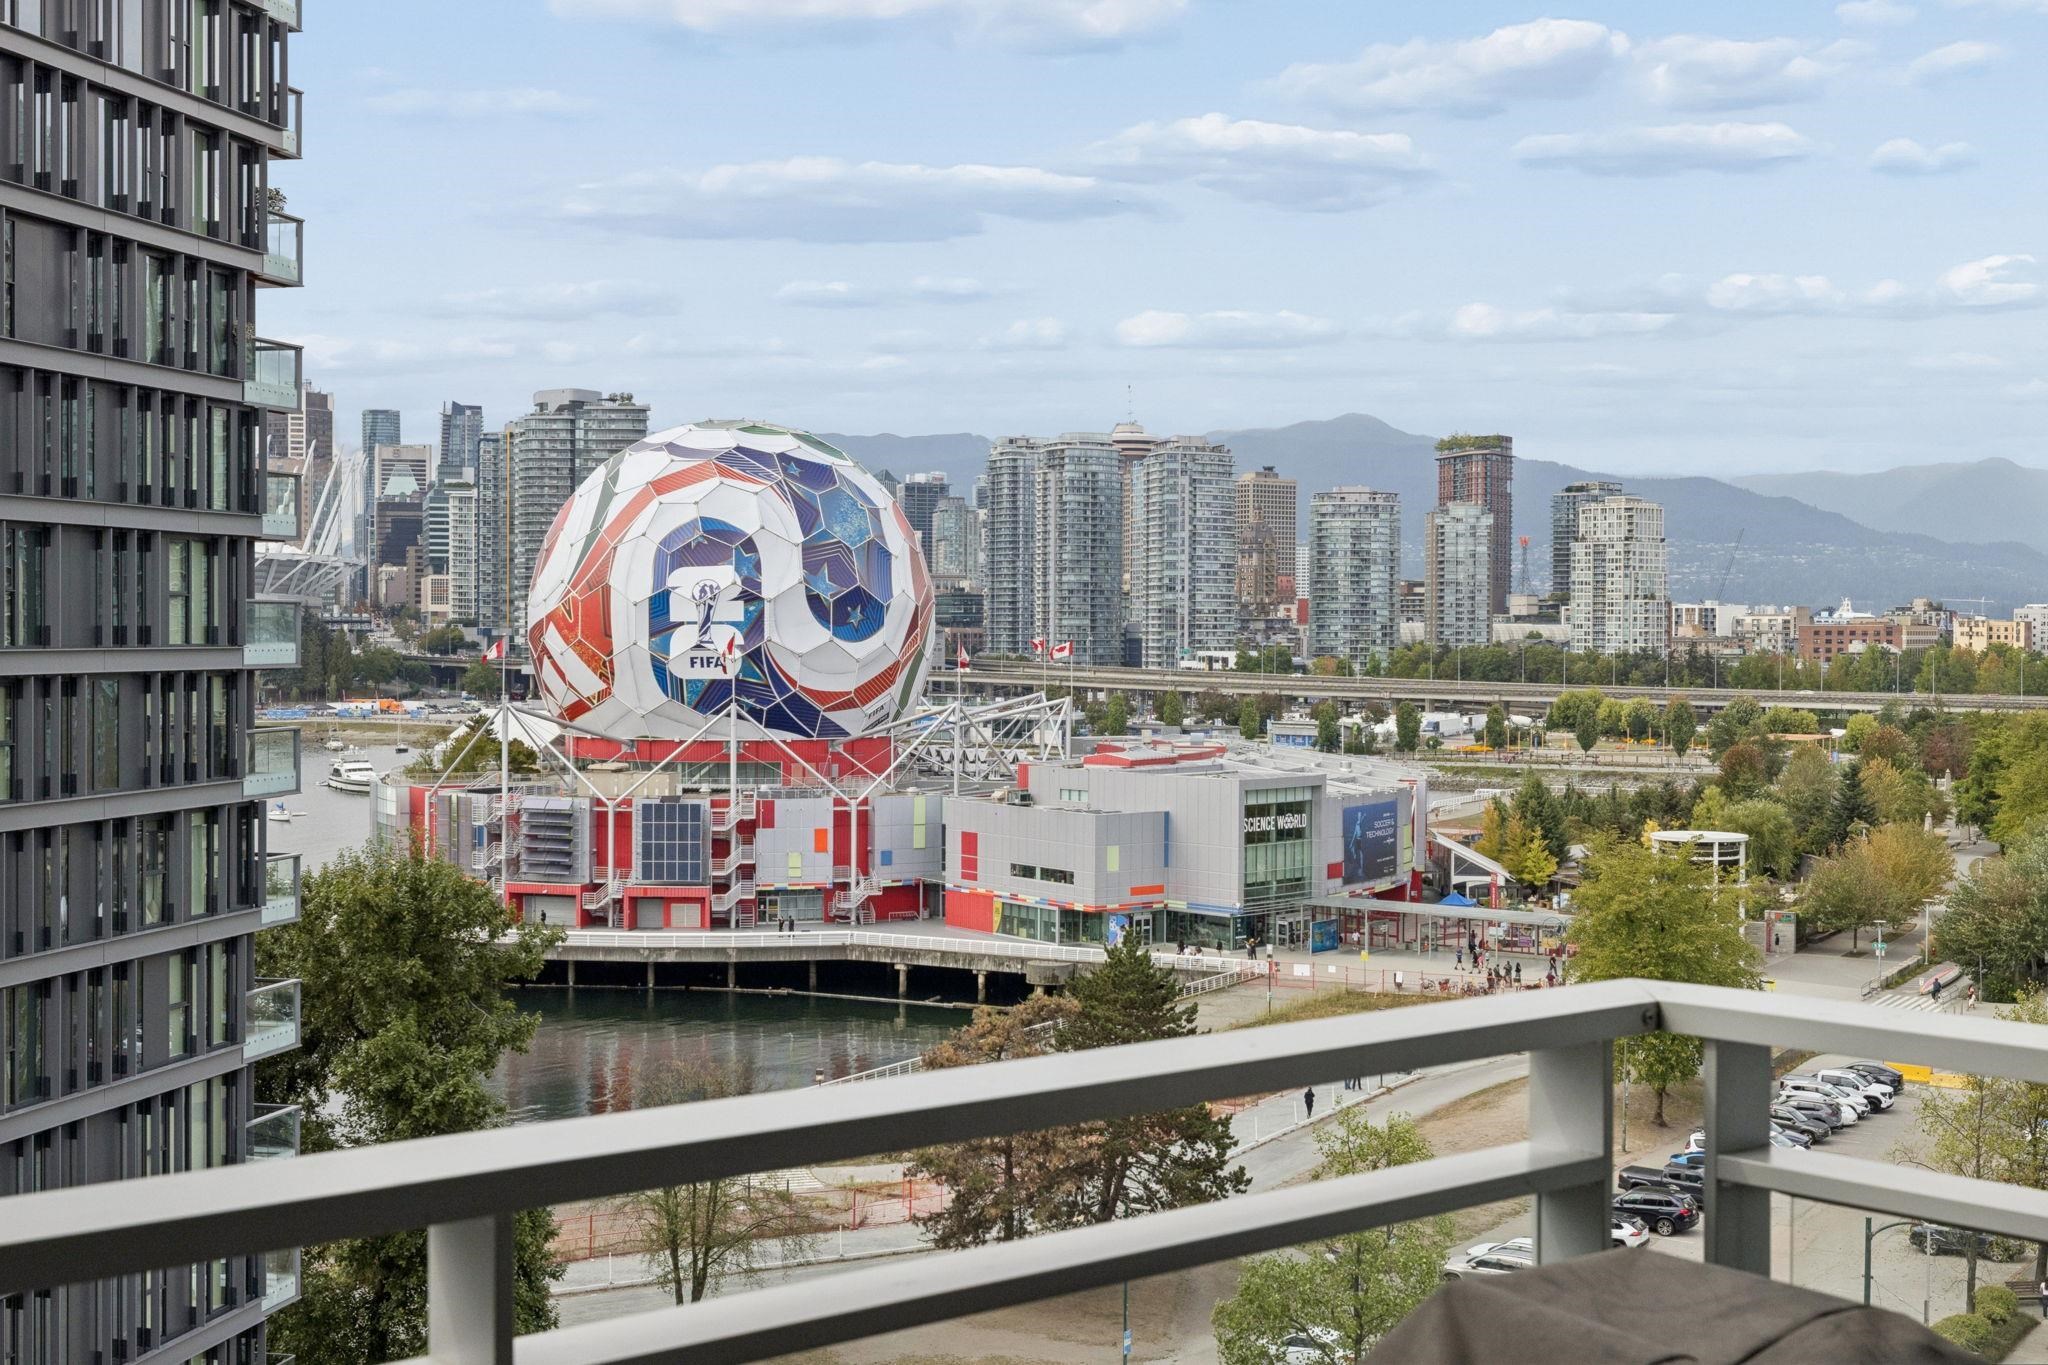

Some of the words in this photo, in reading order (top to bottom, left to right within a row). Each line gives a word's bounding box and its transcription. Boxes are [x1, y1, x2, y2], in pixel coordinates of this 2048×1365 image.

[1958, 620, 1986, 628] WEST
[690, 656, 724, 668] FIFA
[1244, 816, 1275, 832] SCIENCE
[1277, 813, 1307, 830] WORLD
[1366, 827, 1394, 839] TECHNOLOGY
